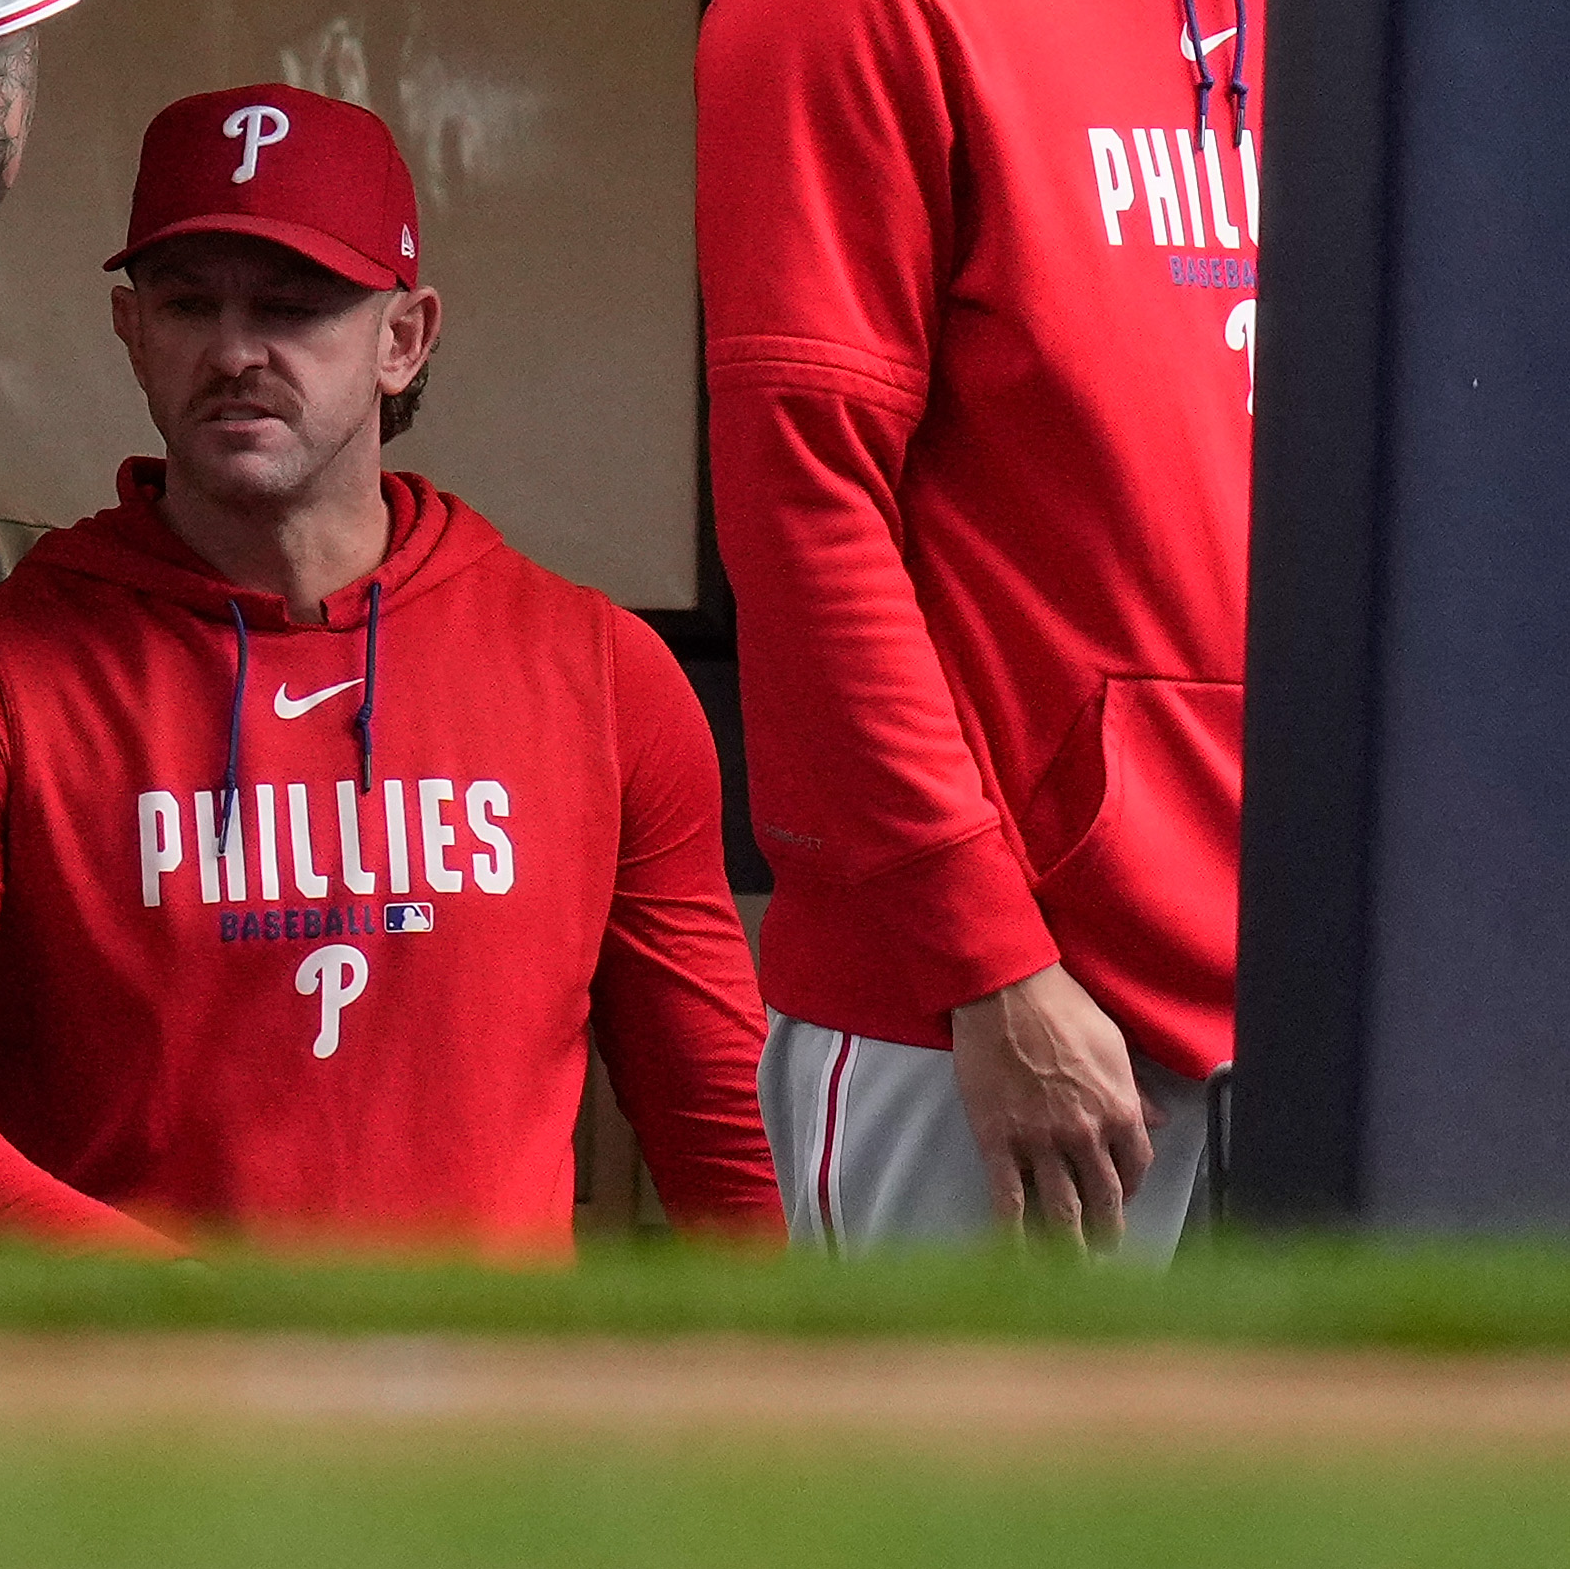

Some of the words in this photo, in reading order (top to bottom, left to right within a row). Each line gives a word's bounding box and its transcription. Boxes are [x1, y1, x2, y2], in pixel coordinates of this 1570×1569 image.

[222, 105, 289, 184] P
[138, 778, 515, 908] PHILLIES
[220, 905, 376, 942] BASEBALL
[295, 944, 369, 1059] P
